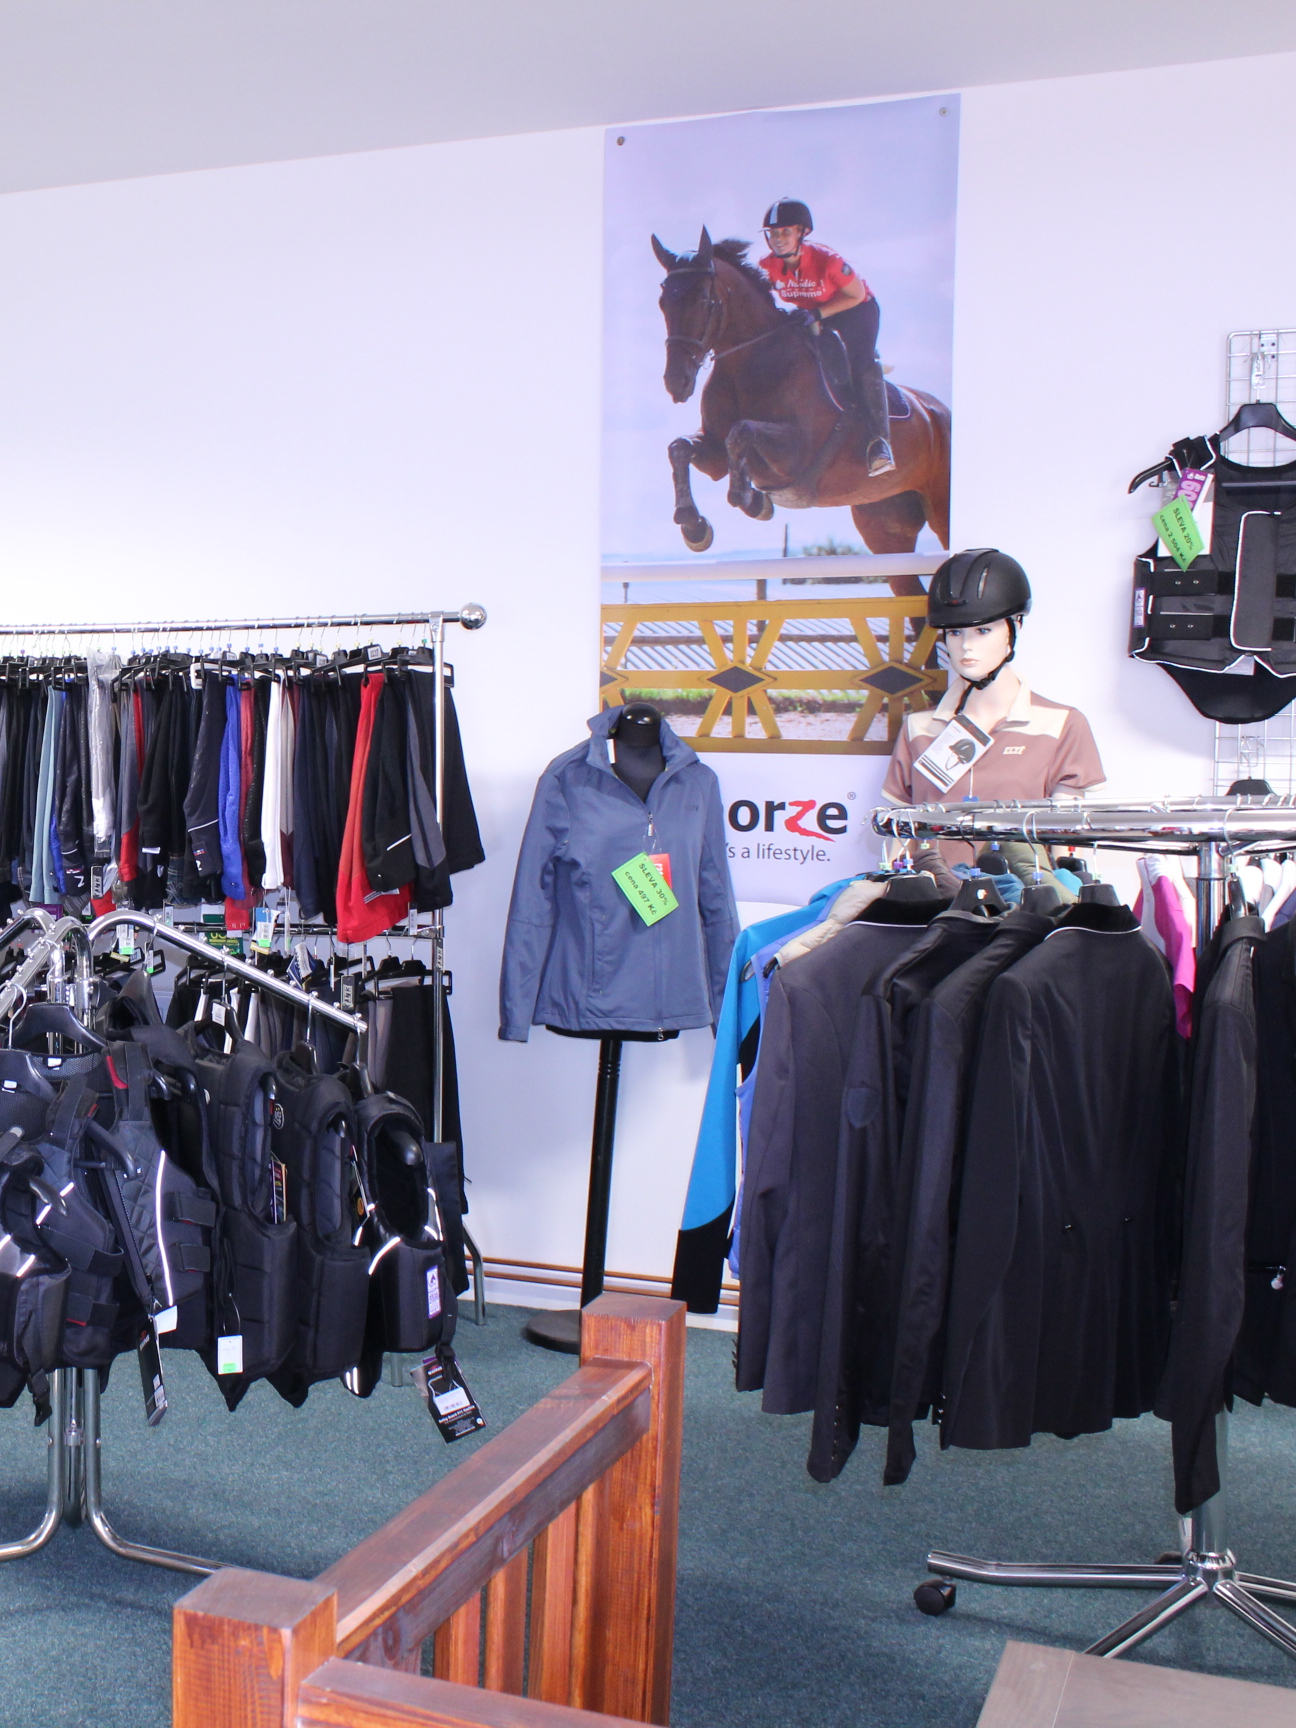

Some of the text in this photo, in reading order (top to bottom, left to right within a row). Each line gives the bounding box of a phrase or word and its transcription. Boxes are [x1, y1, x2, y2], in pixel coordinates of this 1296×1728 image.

[780, 289, 822, 298] Supreme
[1159, 515, 1169, 532] cena
[1173, 508, 1194, 550] SLEVA 20%
[728, 799, 848, 843] orze
[741, 847, 751, 859] a
[756, 843, 831, 865] lifestyle.
[624, 871, 657, 915] cena 497 Kč
[638, 863, 658, 888] SLEVA
[656, 889, 669, 906] 30%
